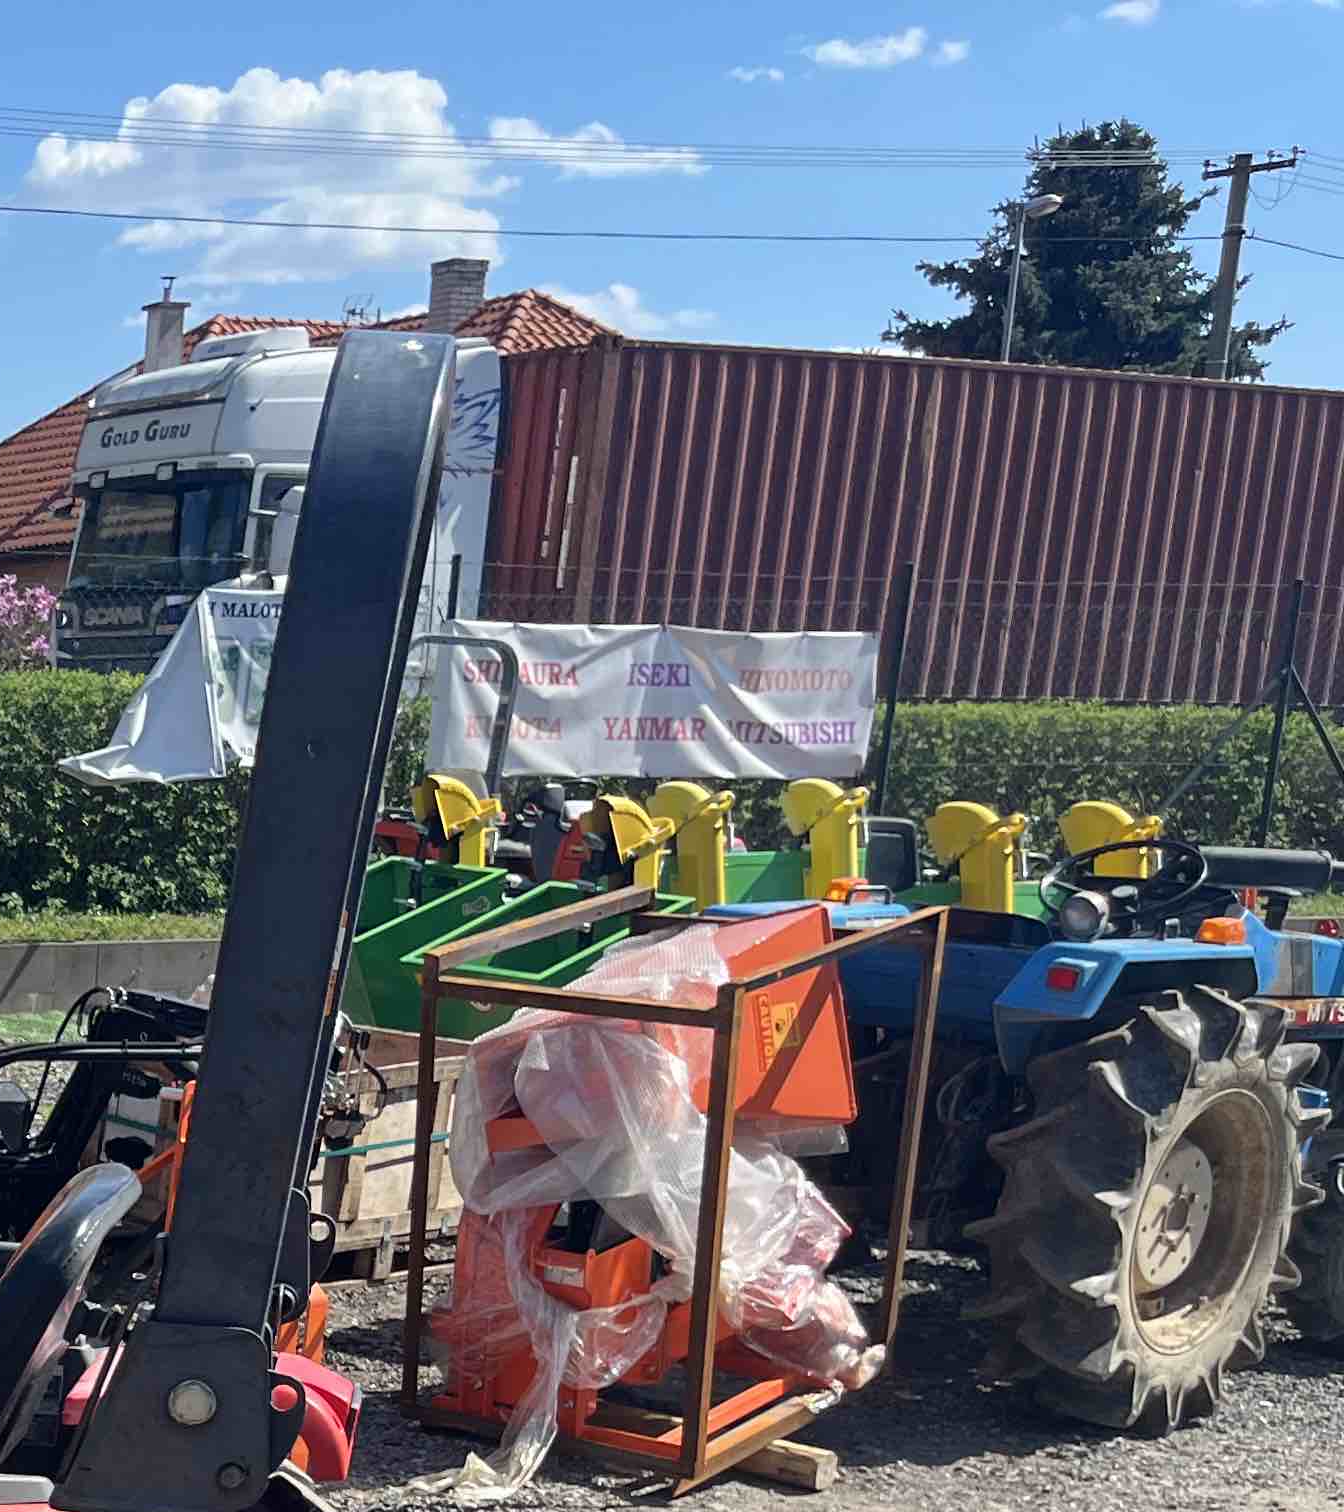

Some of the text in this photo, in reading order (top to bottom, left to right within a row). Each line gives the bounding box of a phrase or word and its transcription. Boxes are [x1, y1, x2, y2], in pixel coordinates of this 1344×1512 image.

[464, 659, 578, 687] SHIAURA
[627, 663, 691, 687] ISEKI
[603, 716, 706, 741] YANMAR
